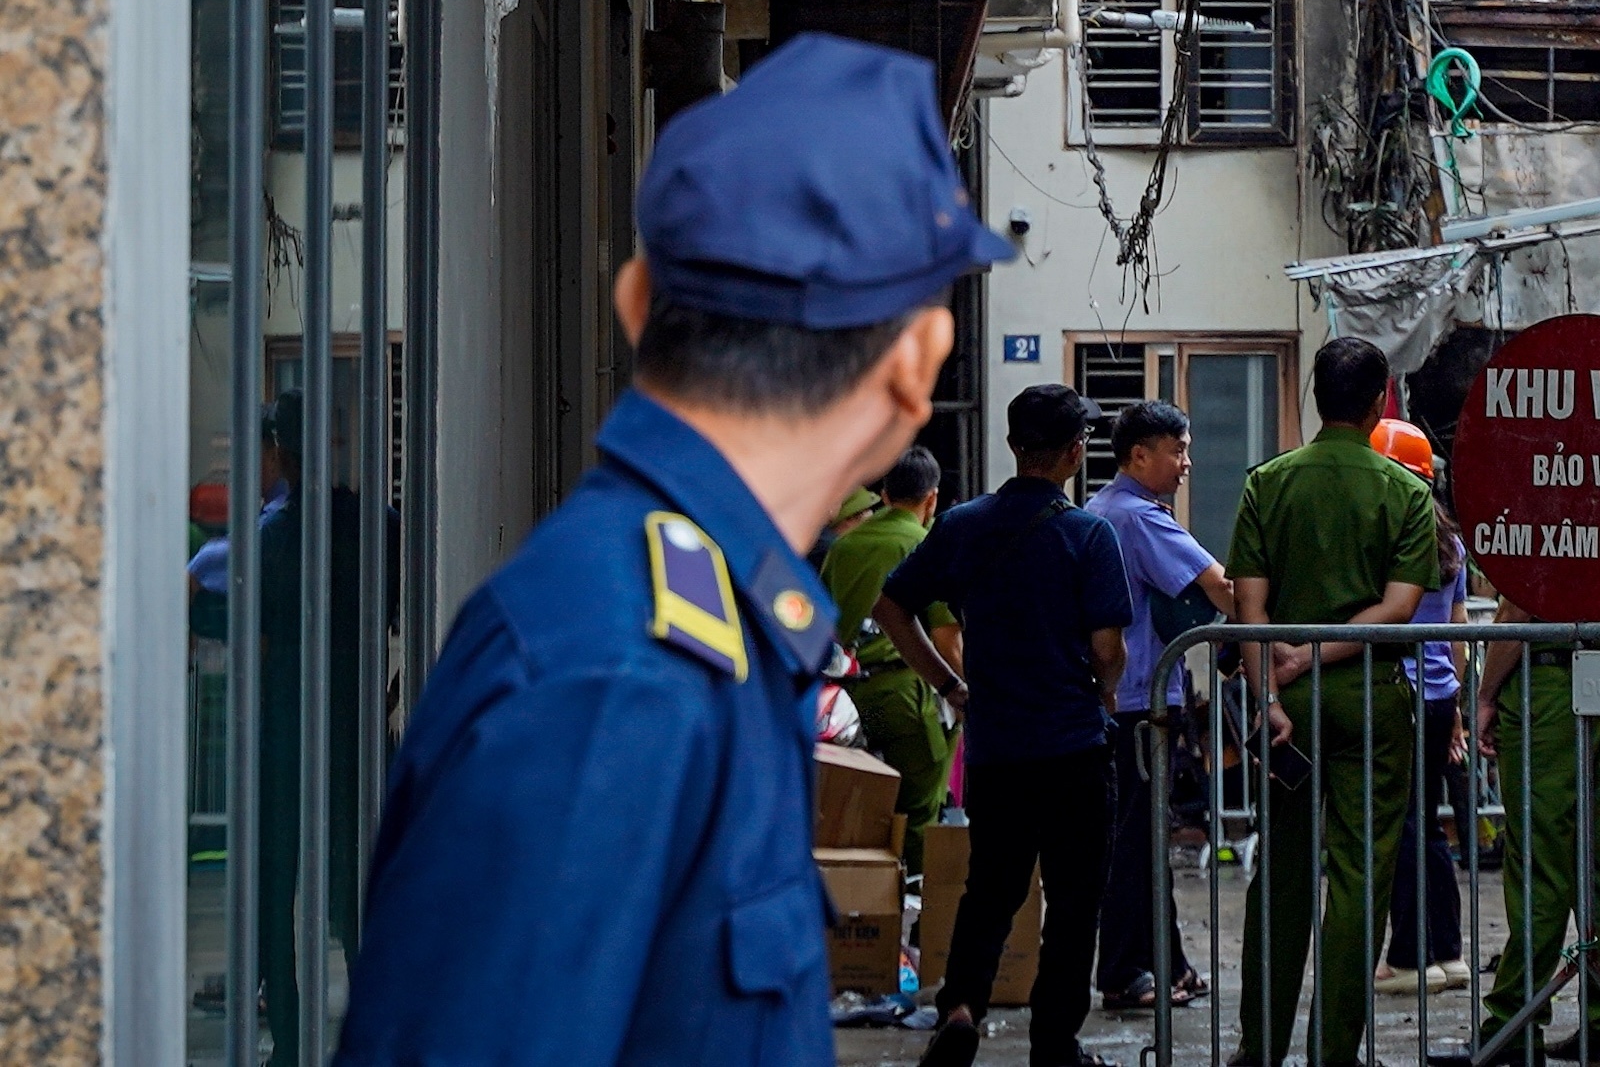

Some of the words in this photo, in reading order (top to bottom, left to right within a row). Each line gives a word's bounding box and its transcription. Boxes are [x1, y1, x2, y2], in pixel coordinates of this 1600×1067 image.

[1486, 367, 1576, 421] KHU
[1533, 441, 1585, 487] BẢO
[1474, 508, 1533, 557] CẤM
[1540, 518, 1600, 559] XÂM
